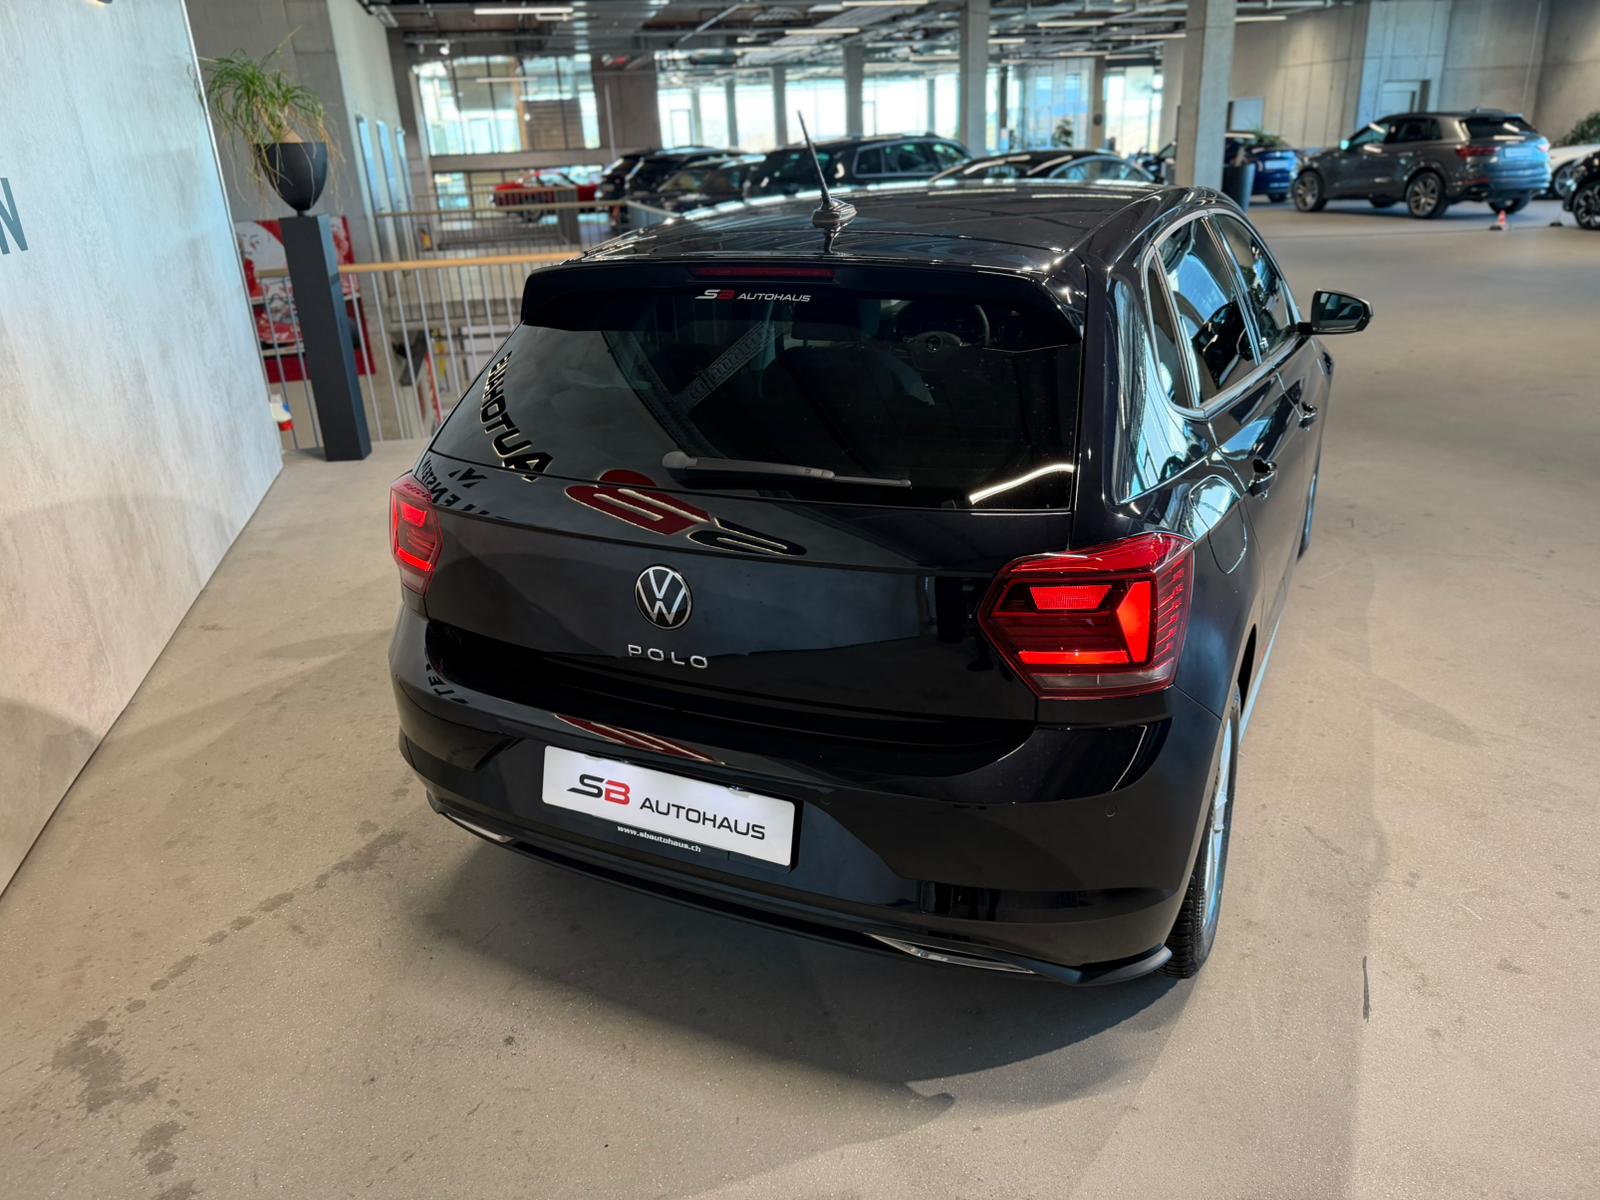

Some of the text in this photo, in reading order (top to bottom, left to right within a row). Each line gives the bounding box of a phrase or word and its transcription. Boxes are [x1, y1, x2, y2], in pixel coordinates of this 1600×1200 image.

[694, 288, 812, 303] SB AUTOHAUS
[628, 644, 709, 669] POLO
[566, 773, 766, 841] SB AUTOHAUS
[617, 825, 702, 853] www.sbautohaus.ch
